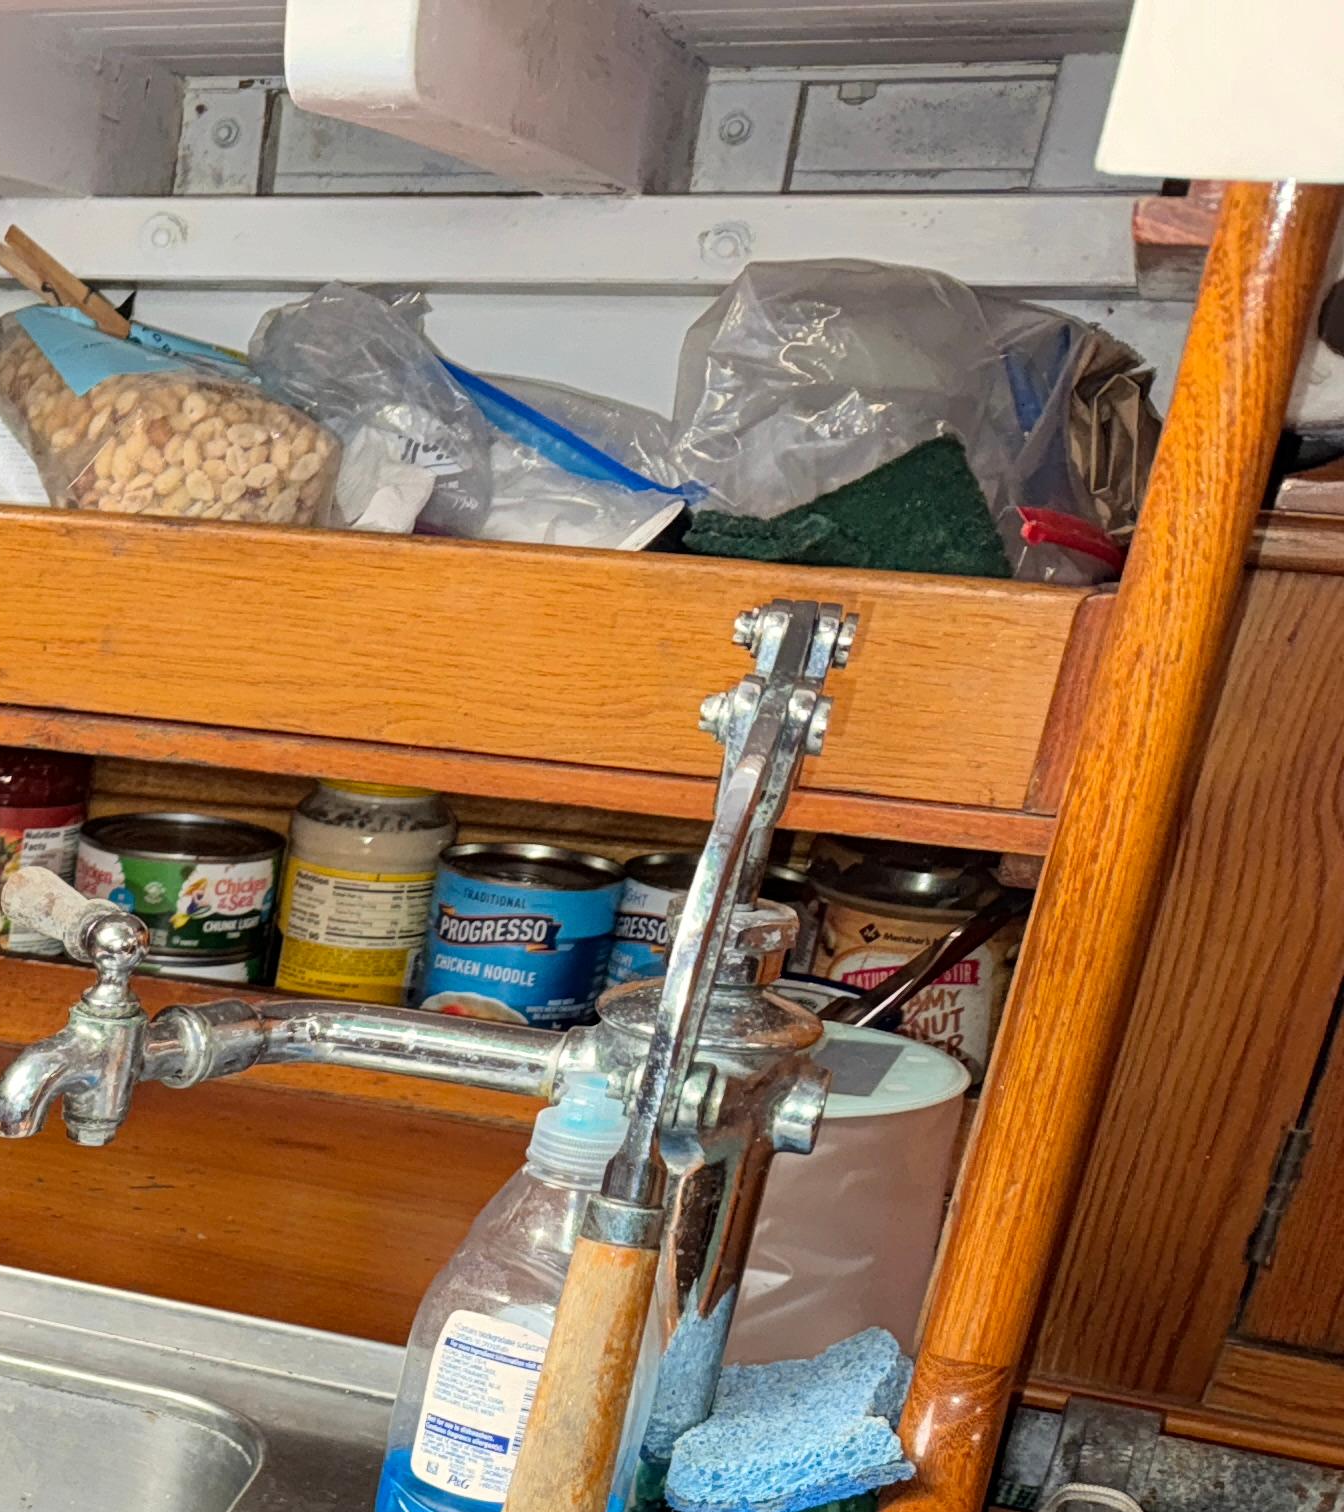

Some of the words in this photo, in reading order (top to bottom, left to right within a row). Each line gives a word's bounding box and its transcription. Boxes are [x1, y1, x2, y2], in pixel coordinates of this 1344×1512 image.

[230, 893, 256, 911] Sea
[463, 888, 528, 909] TRADITIONAL
[438, 914, 549, 944] PROGRESSO
[616, 915, 667, 944] GRESSO
[883, 932, 931, 945] Member's
[434, 953, 481, 977] CHICKEN
[484, 963, 537, 988] NOODLE
[942, 963, 972, 983] STIR
[445, 1473, 472, 1490] P&G
